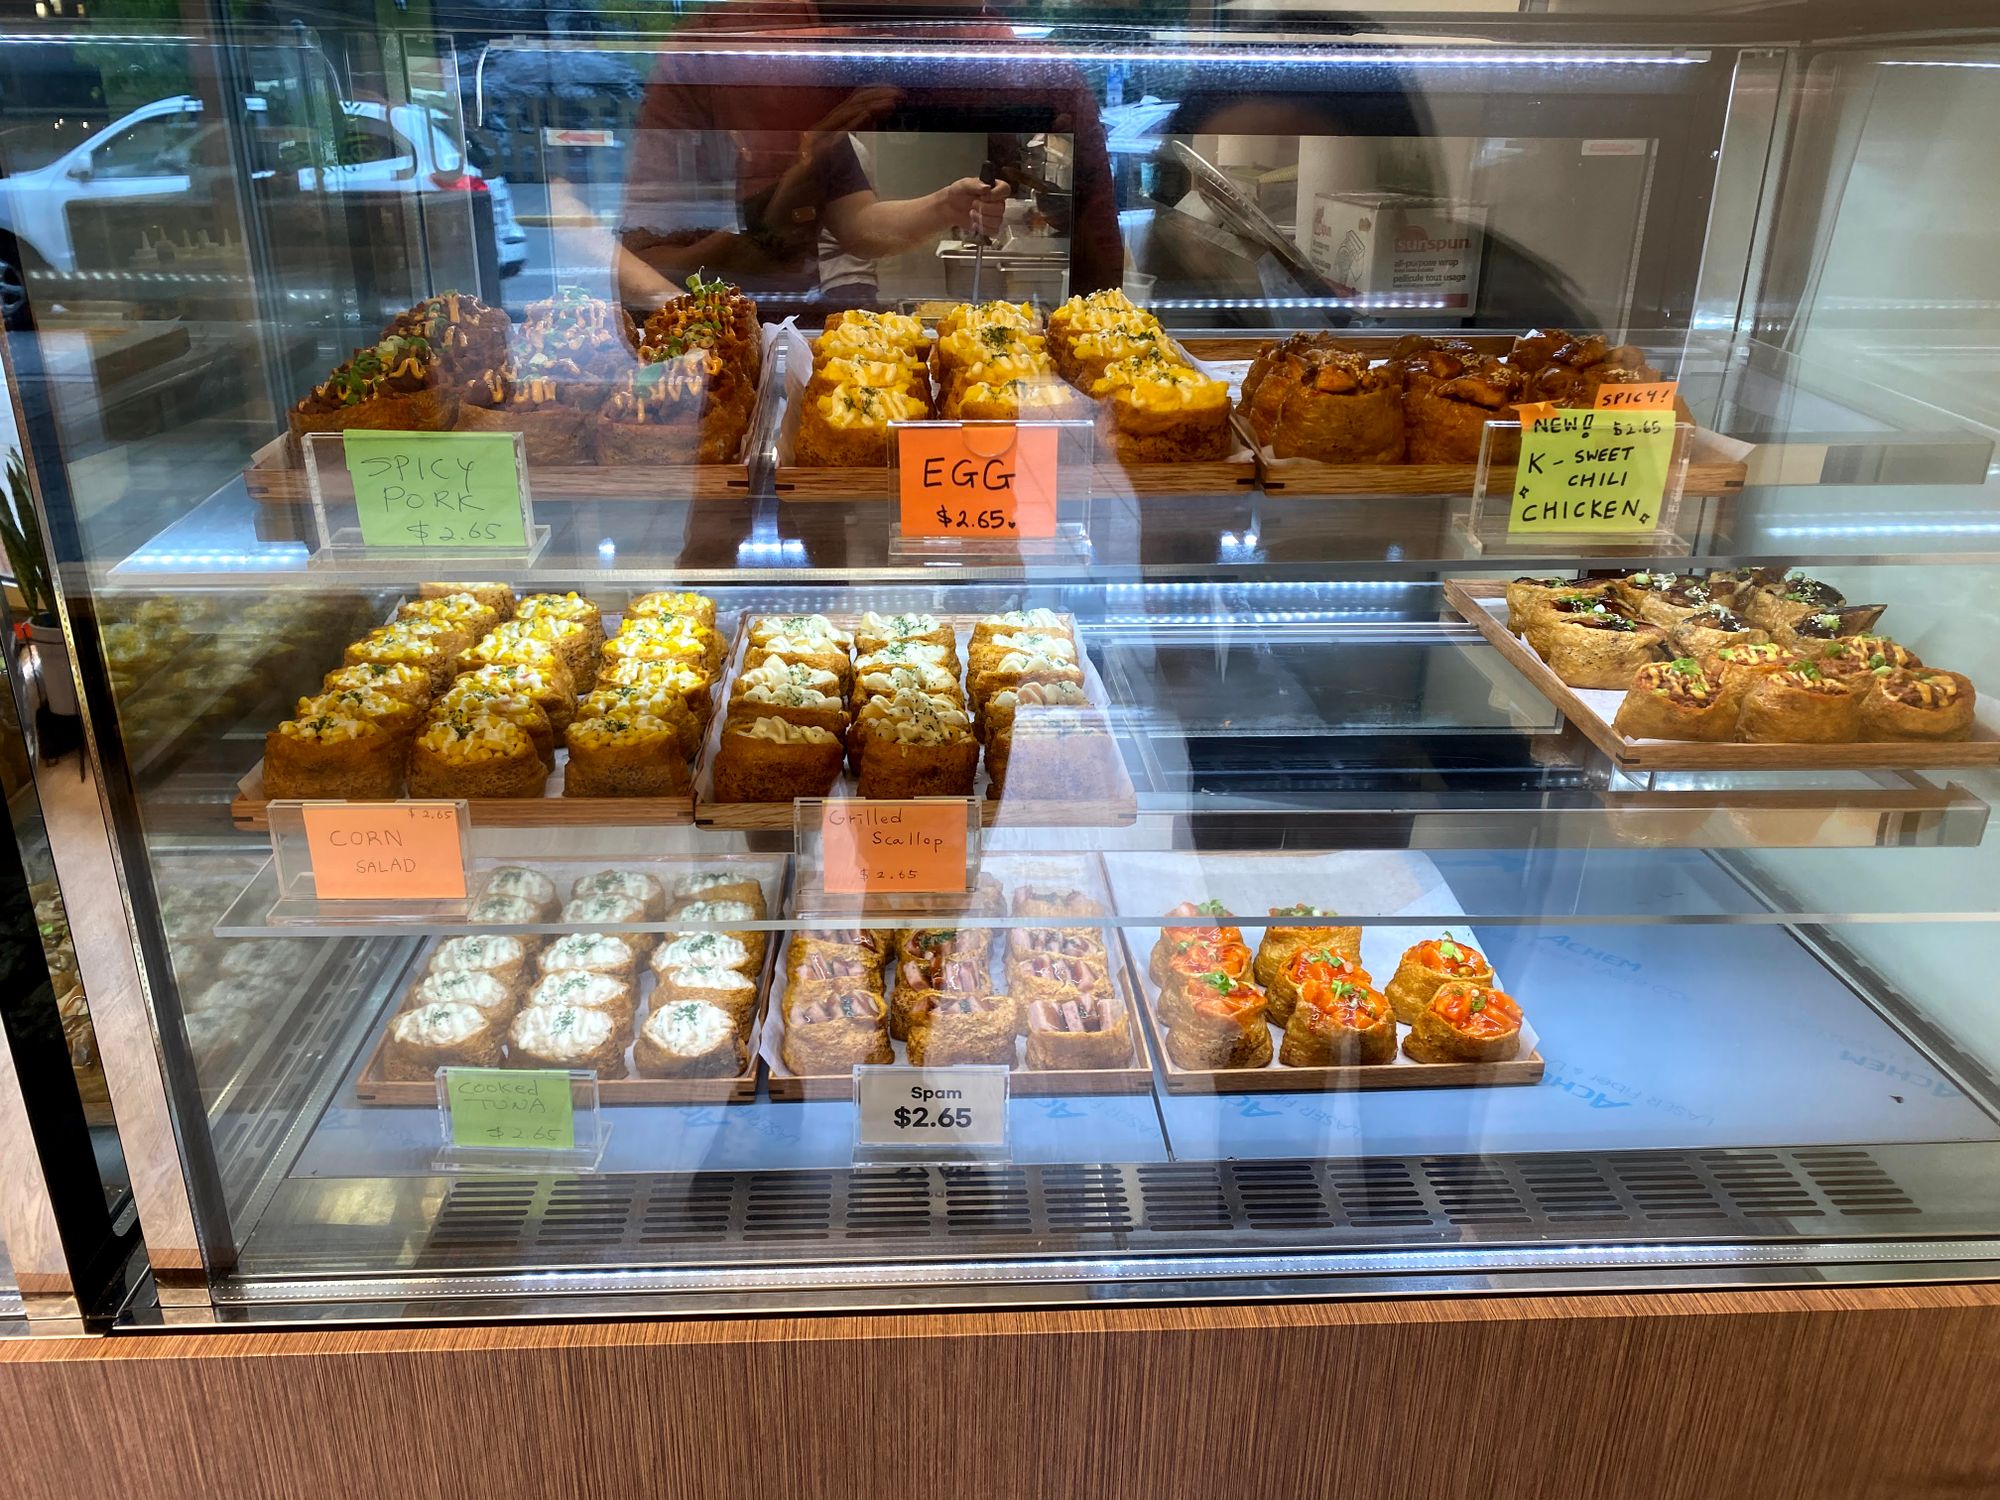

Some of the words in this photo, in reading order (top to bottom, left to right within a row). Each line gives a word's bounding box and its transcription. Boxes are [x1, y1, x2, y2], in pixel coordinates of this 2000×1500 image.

[1439, 259, 1459, 268] wrap
[1425, 274, 1442, 282] tout
[1443, 274, 1466, 283] usage
[1602, 390, 1671, 406] SPICY!
[1613, 420, 1662, 436] $2.65
[1575, 446, 1635, 463] SWEET
[361, 455, 475, 493] SPICY
[923, 457, 1016, 490] EGG
[1567, 472, 1628, 487] CHILI
[384, 486, 485, 512] PORK
[937, 505, 1005, 528] $2.65
[1521, 499, 1640, 522] CHICKEN
[407, 520, 501, 545] $2.65
[829, 808, 902, 826] Grilled
[329, 830, 403, 847] CORN
[872, 831, 944, 853] Scallop
[356, 858, 416, 874] SALAD
[911, 1087, 962, 1102] Spam
[463, 1098, 546, 1113] TUNA
[894, 1106, 972, 1129] $2.65
